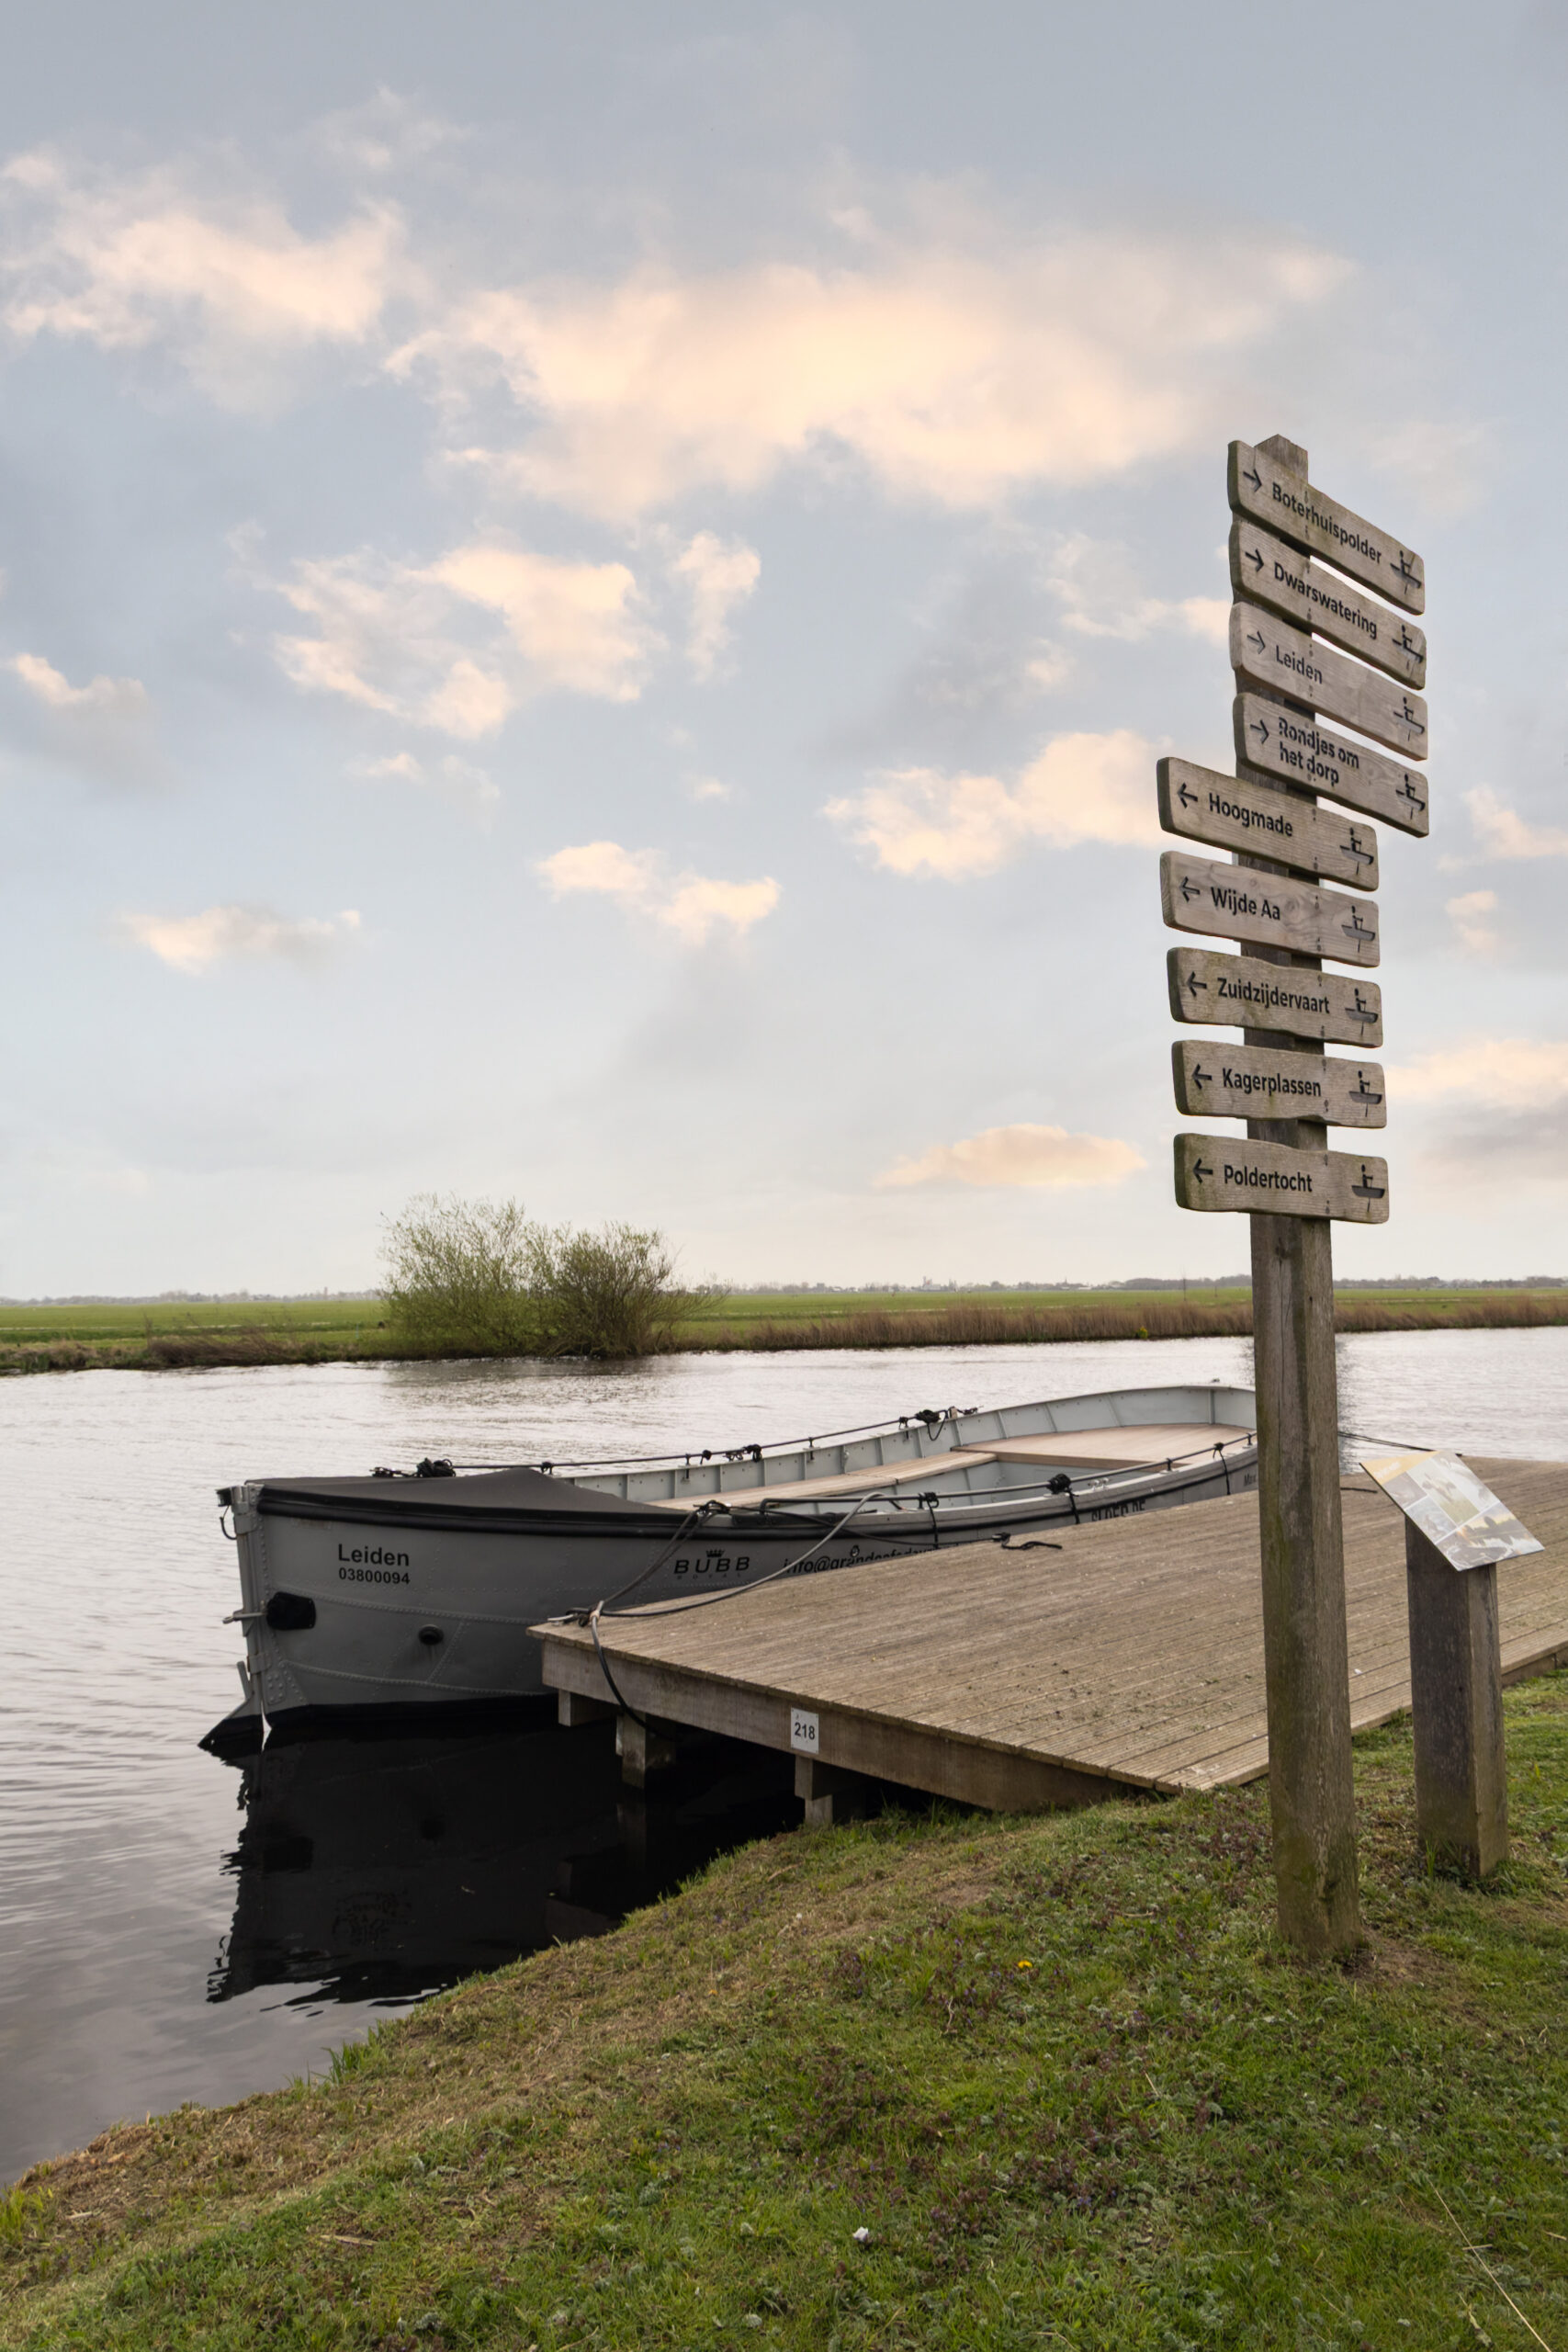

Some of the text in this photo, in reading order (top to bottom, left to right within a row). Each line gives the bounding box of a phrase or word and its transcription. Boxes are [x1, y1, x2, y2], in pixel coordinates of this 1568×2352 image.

[1271, 481, 1382, 564] Boterhuispolder
[1273, 560, 1378, 639] Dwarswatering
[1275, 644, 1323, 684] Leiden
[1278, 717, 1359, 769] Rondjes om
[1279, 741, 1339, 786] het dorp
[1208, 792, 1293, 837] Hoogmade
[1210, 886, 1280, 921] Wijde Aa
[1216, 977, 1330, 1013] Zuidzijdervaart
[1222, 1067, 1322, 1097] Kagerplassen
[1224, 1164, 1313, 1193] Poldertocht
[338, 1543, 410, 1566] Leiden
[673, 1556, 750, 1575] BUBB
[338, 1566, 411, 1585] 03800094
[794, 1722, 816, 1740] 218
